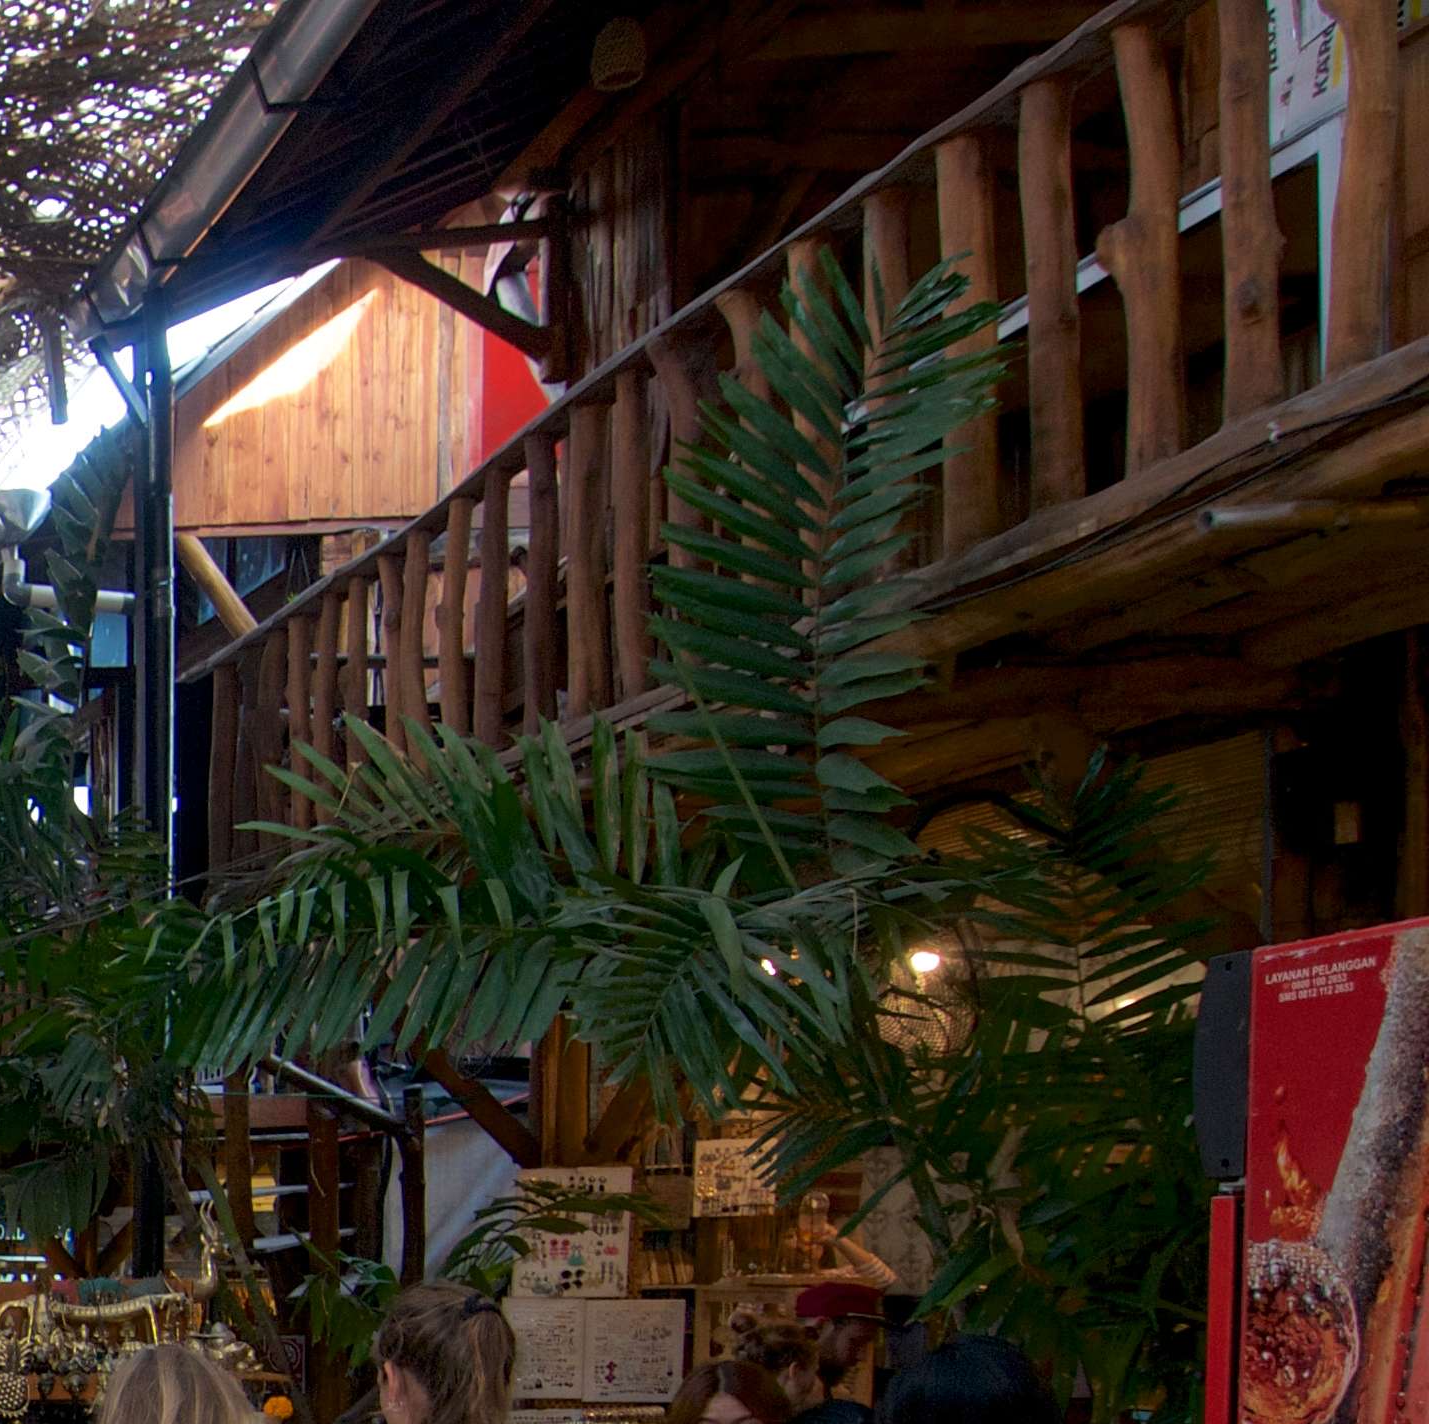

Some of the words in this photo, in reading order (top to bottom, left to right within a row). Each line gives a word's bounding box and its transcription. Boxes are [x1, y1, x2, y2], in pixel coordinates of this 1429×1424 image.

[1264, 968, 1310, 985] LAYANAN
[1312, 957, 1376, 976] PELANGGAN
[1278, 991, 1297, 1003] SMS
